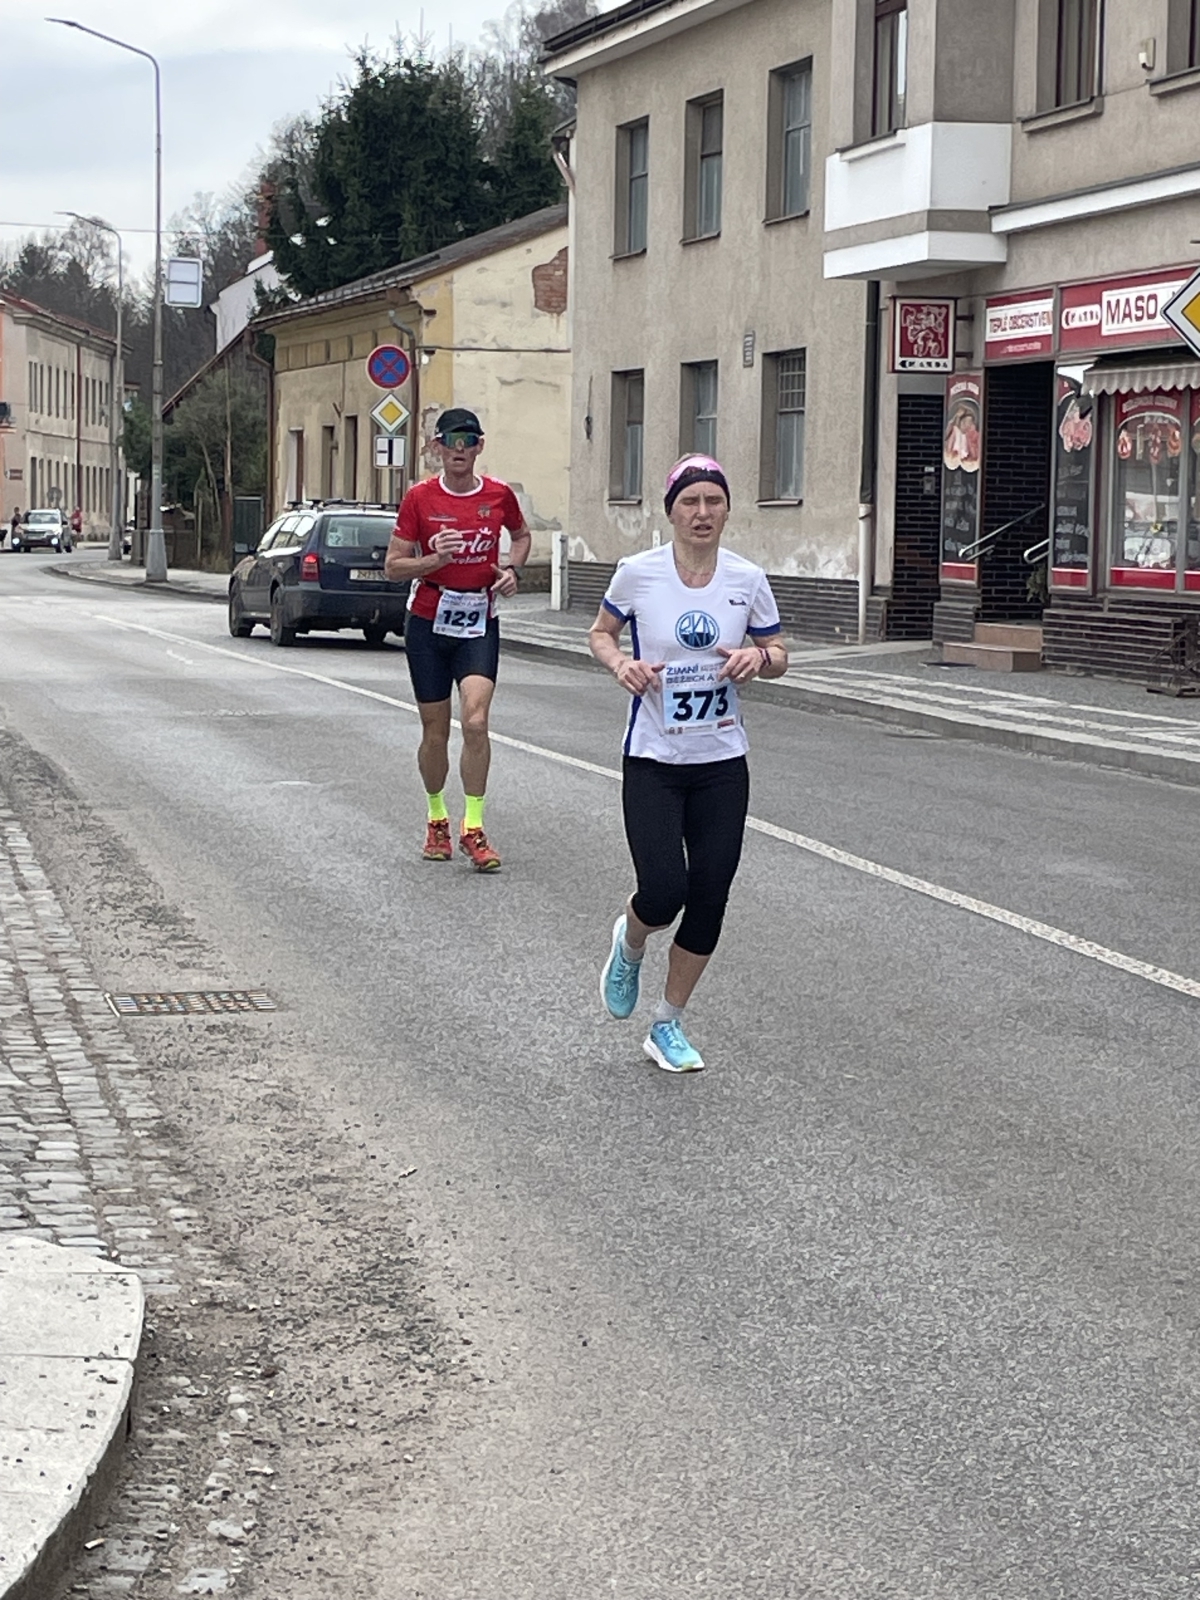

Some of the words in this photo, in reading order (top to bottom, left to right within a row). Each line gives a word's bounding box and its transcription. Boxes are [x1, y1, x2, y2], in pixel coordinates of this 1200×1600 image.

[1106, 293, 1158, 326] MASO
[443, 610, 480, 627] 129
[667, 664, 699, 675] ZIMNÍ
[673, 686, 729, 722] 373
